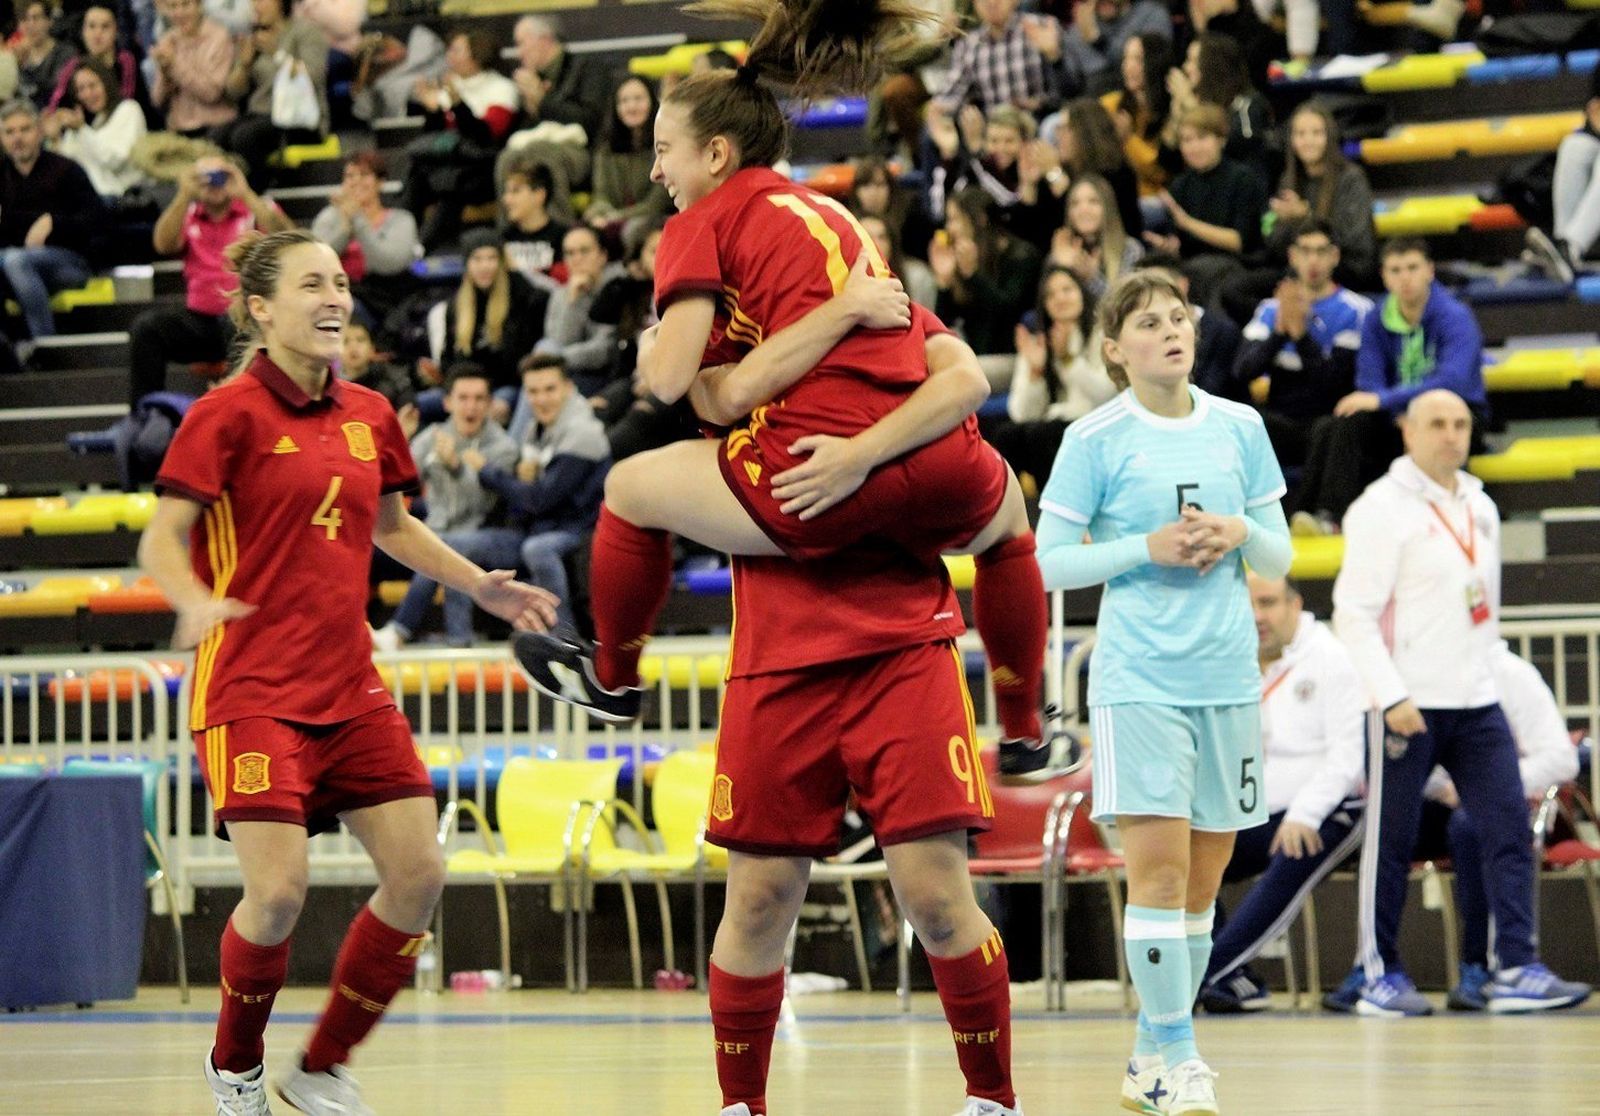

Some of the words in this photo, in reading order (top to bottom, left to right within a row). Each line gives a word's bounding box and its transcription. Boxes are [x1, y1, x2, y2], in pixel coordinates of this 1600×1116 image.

[311, 475, 344, 541] 4
[948, 734, 975, 804] 9
[1239, 756, 1257, 814] 5
